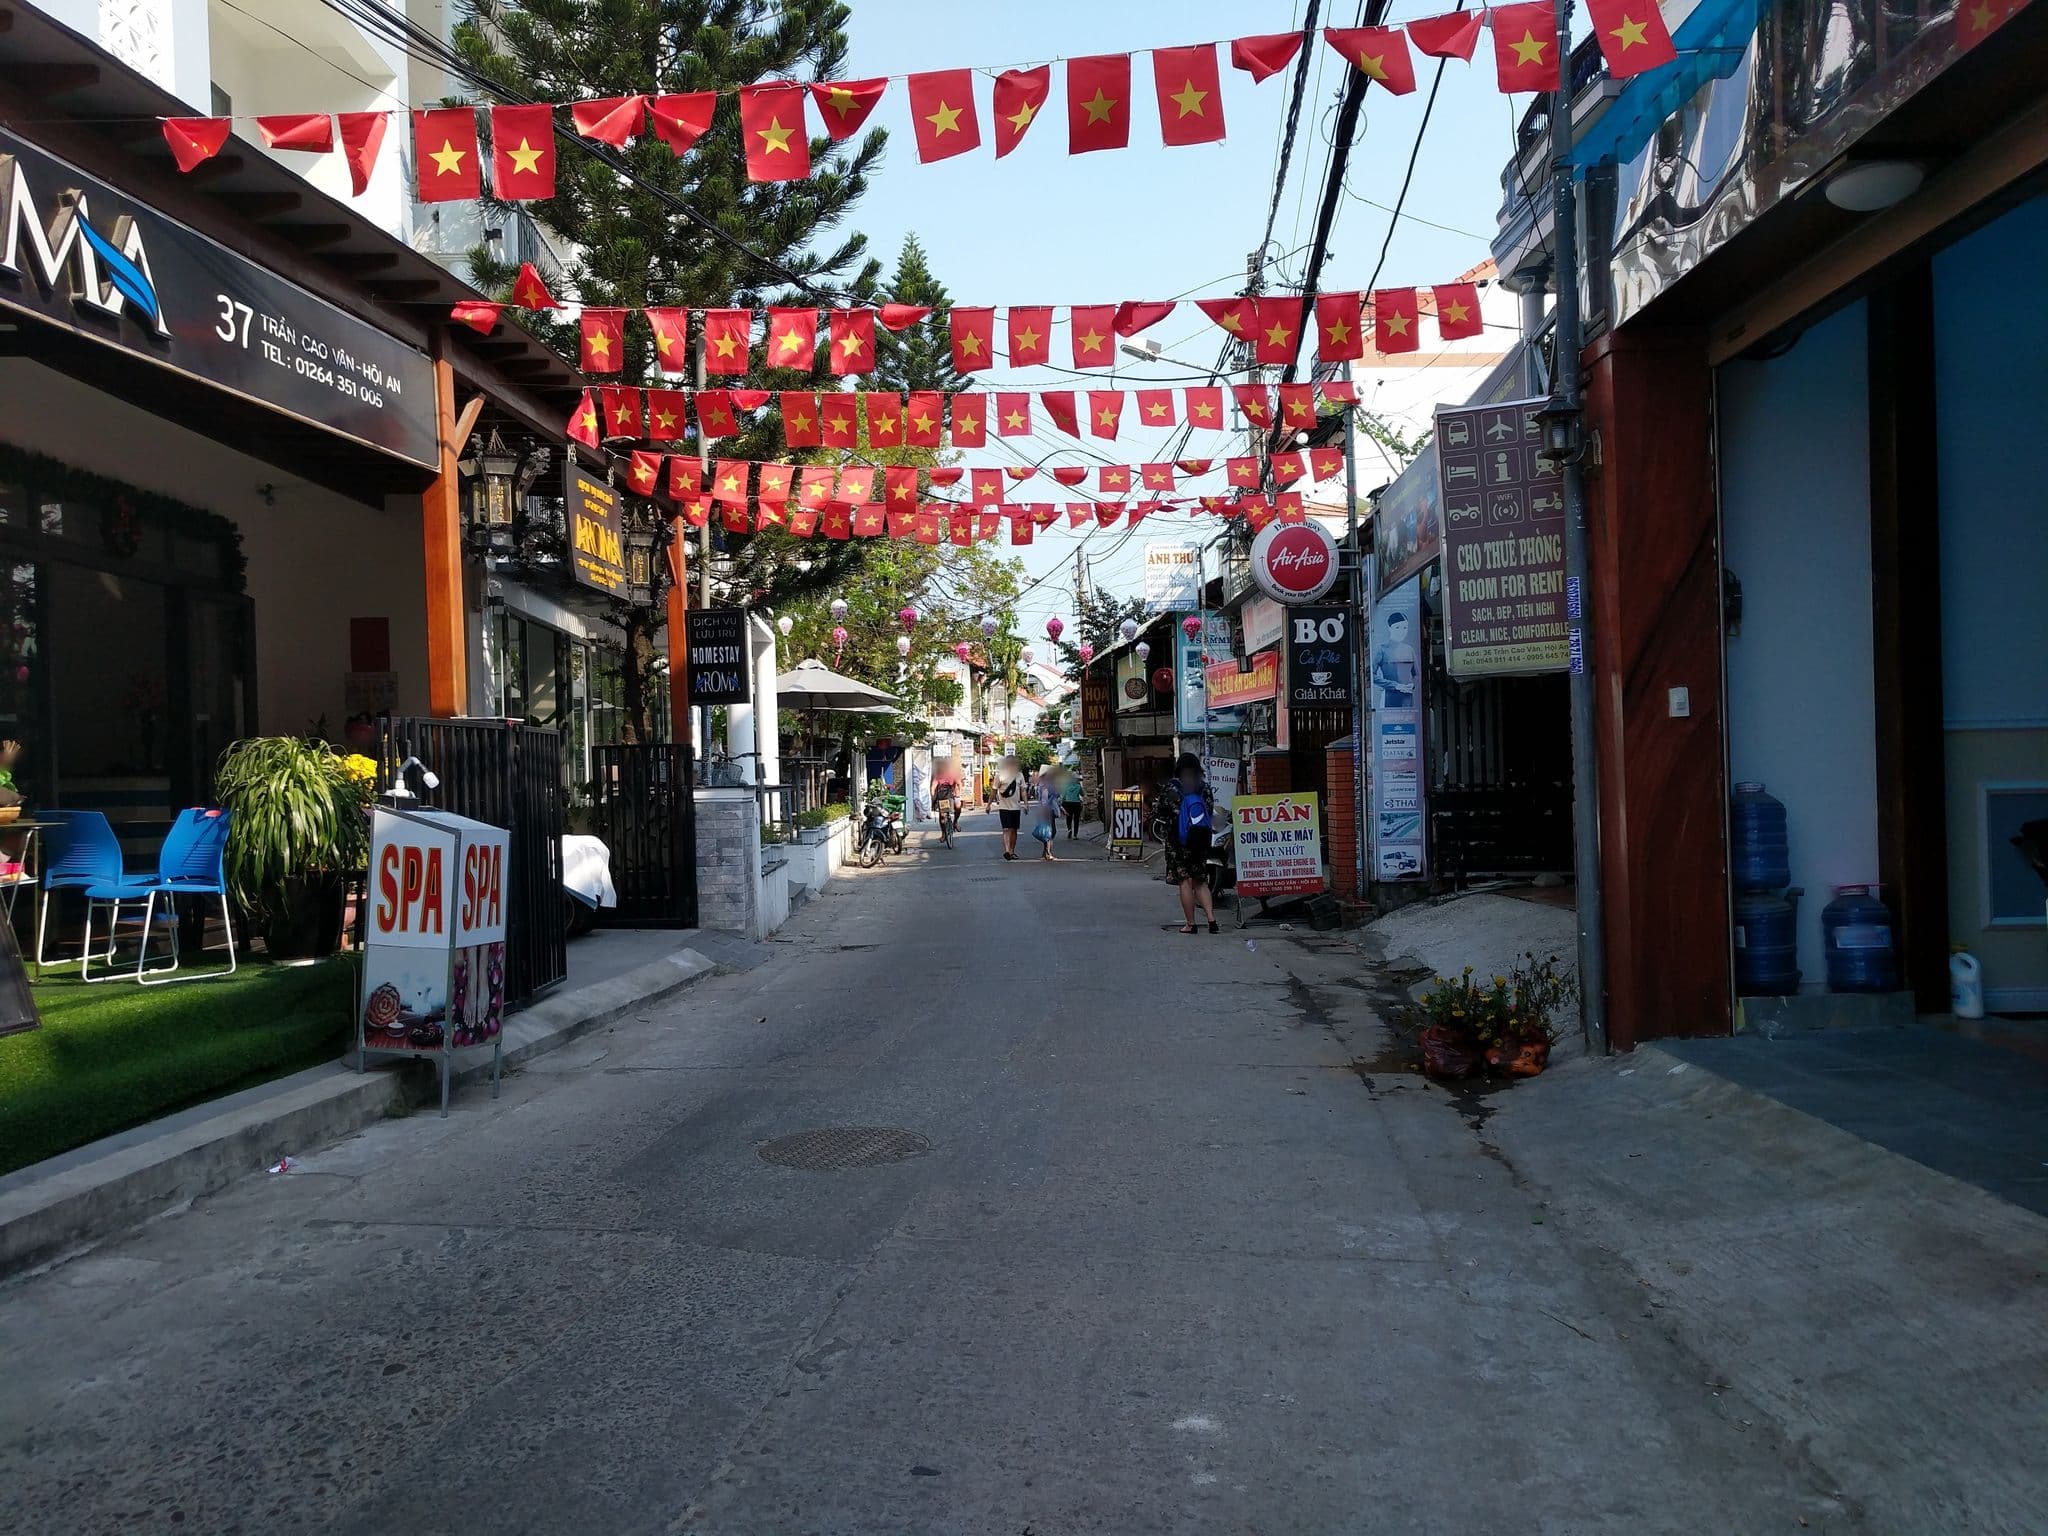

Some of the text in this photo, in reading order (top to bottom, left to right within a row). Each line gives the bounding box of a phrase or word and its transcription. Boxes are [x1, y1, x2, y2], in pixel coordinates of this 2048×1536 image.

[215, 294, 254, 349] 37
[260, 313, 297, 347] TRẦN
[301, 334, 329, 360] CAO
[386, 375, 401, 395] AN
[261, 339, 384, 410] TEL: 01264 351 005
[1457, 528, 1562, 572] CHO THUÊ PHÒNG
[1271, 583, 1285, 595] Book
[1459, 570, 1564, 602] ROOM FOR RENT
[1517, 600, 1535, 621] TIỆN
[1536, 601, 1556, 617] NGHI
[1294, 612, 1345, 644] BƠ
[1461, 621, 1570, 645] CLEAN, NICE, COMFORTABLE
[692, 645, 740, 665] HOMESTAY
[1319, 687, 1347, 700] Khát
[1115, 808, 1141, 839] SPA
[1238, 798, 1311, 824] TUẤN
[1280, 830, 1292, 842] XE
[1250, 847, 1276, 858] THAY
[376, 843, 443, 935] SPA
[462, 843, 501, 932] SPA
